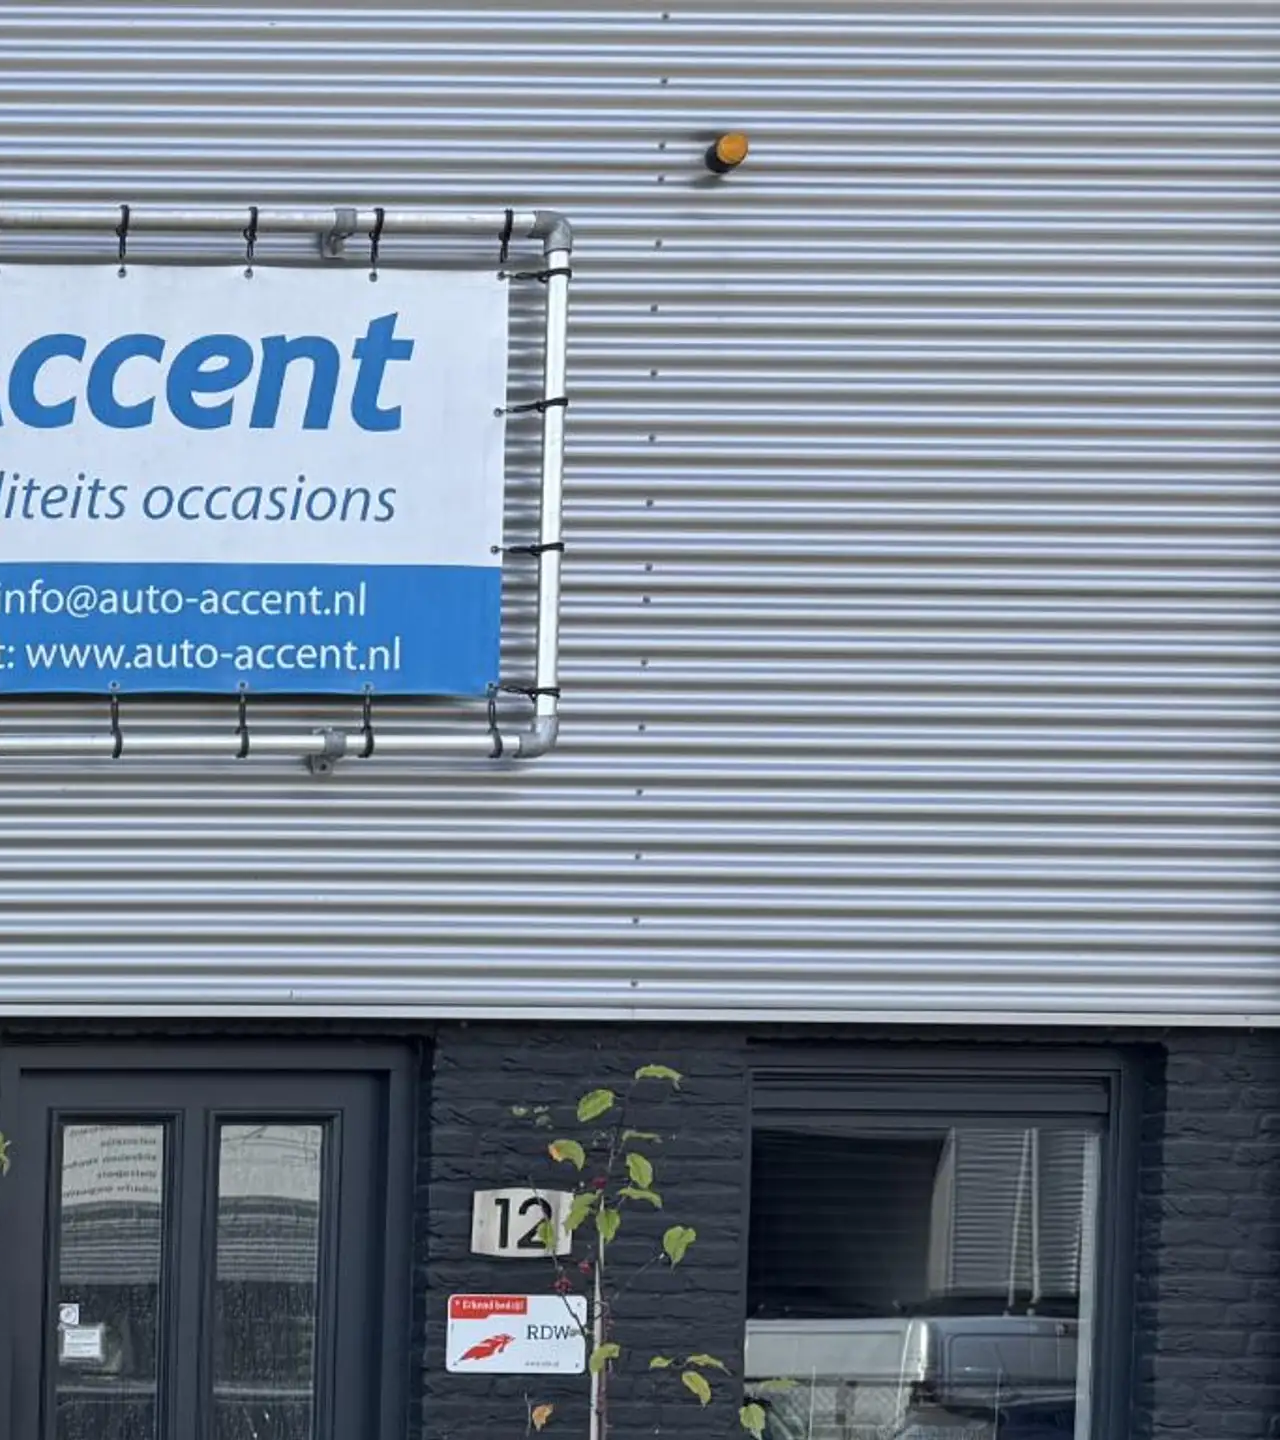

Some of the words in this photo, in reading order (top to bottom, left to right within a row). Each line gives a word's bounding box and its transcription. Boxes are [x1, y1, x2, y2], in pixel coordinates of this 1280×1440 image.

[142, 474, 397, 523] occasions
[25, 636, 401, 671] www.auto-accent.nl
[495, 1197, 552, 1249] 12
[526, 1324, 571, 1341] RDW
